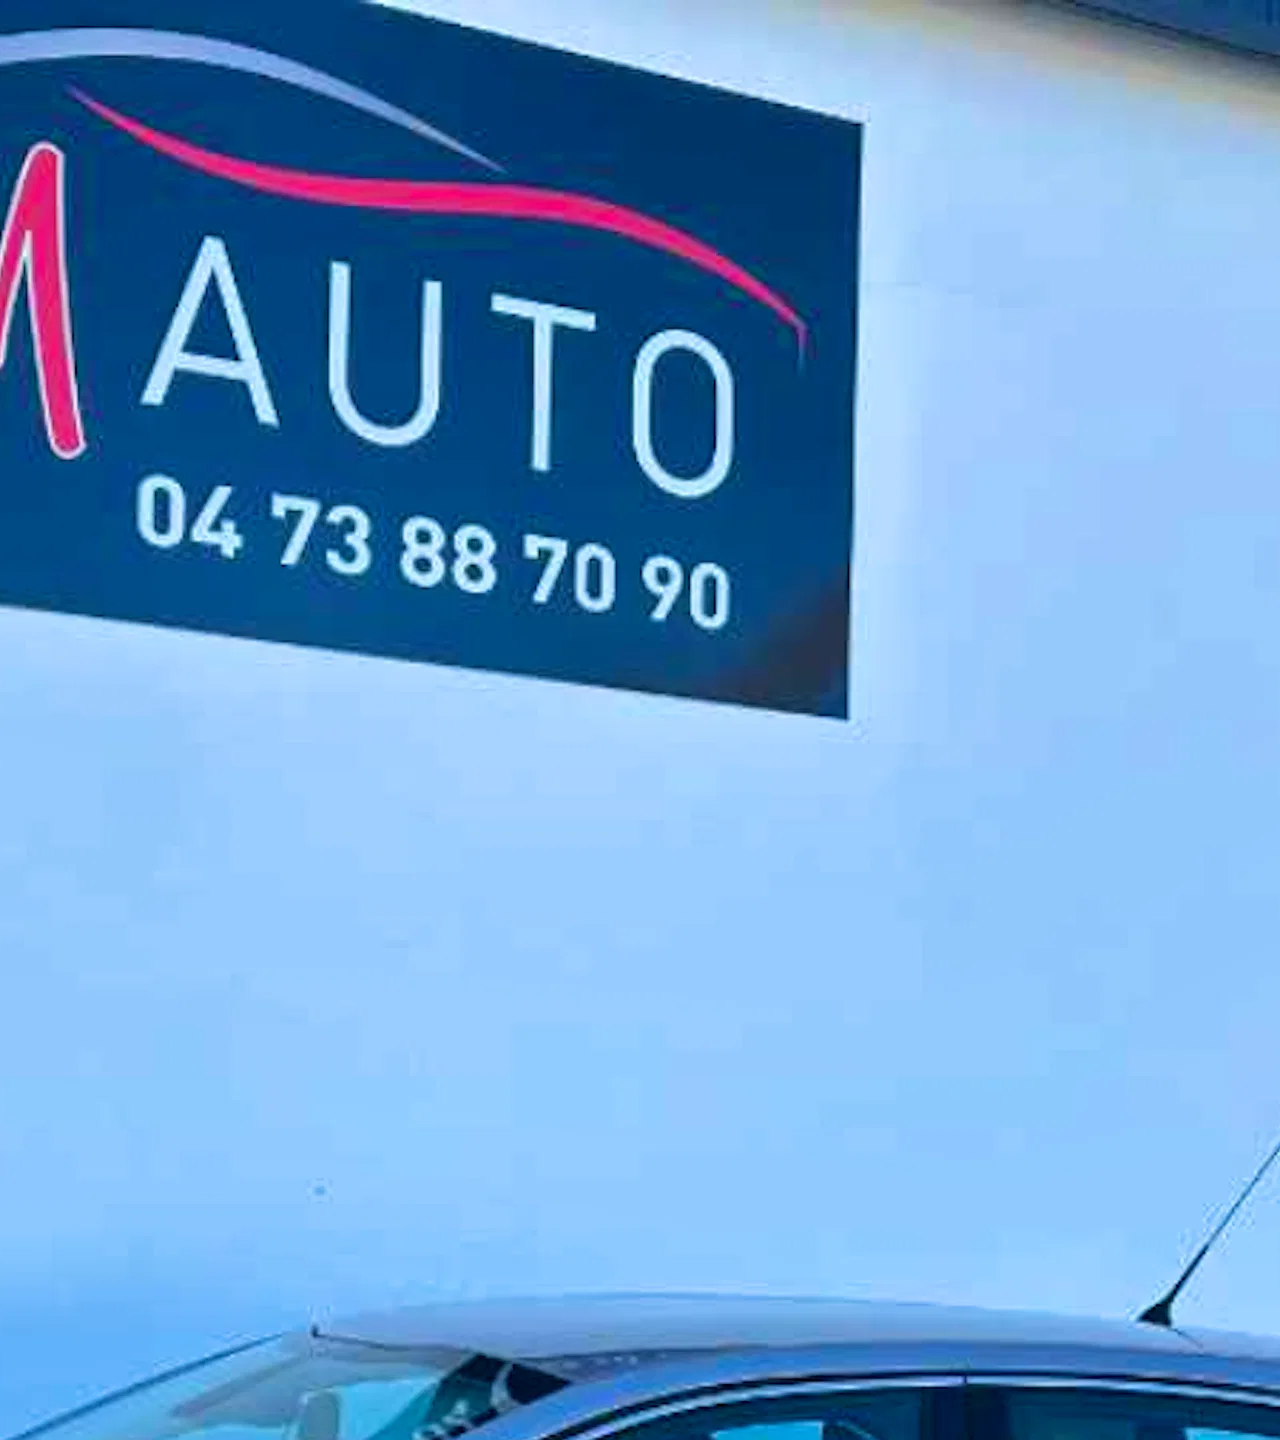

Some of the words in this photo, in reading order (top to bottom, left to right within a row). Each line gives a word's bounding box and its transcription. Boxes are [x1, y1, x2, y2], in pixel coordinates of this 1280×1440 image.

[140, 234, 737, 499] AUTO
[136, 473, 245, 562] 04
[271, 492, 369, 577] 73
[400, 516, 498, 598] 88
[523, 533, 616, 614] 70
[640, 554, 732, 632] 90
